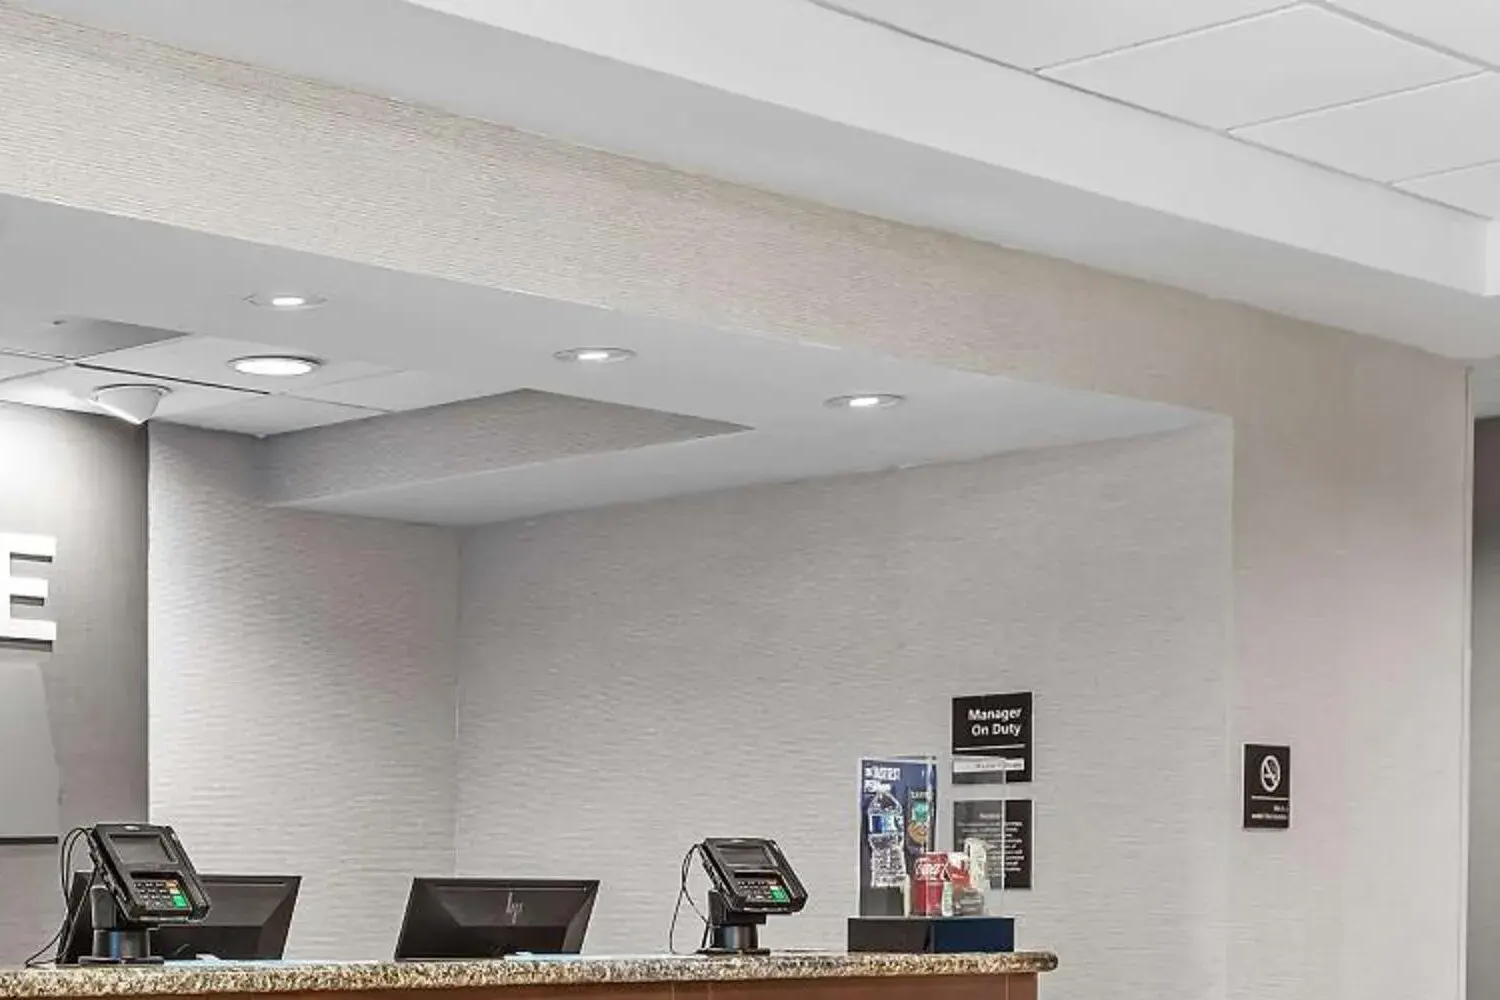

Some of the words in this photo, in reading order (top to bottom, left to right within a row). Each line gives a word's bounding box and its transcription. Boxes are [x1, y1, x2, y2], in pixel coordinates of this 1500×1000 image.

[968, 707, 1022, 722] Manager
[971, 723, 989, 737] On
[992, 722, 1022, 737] Duty
